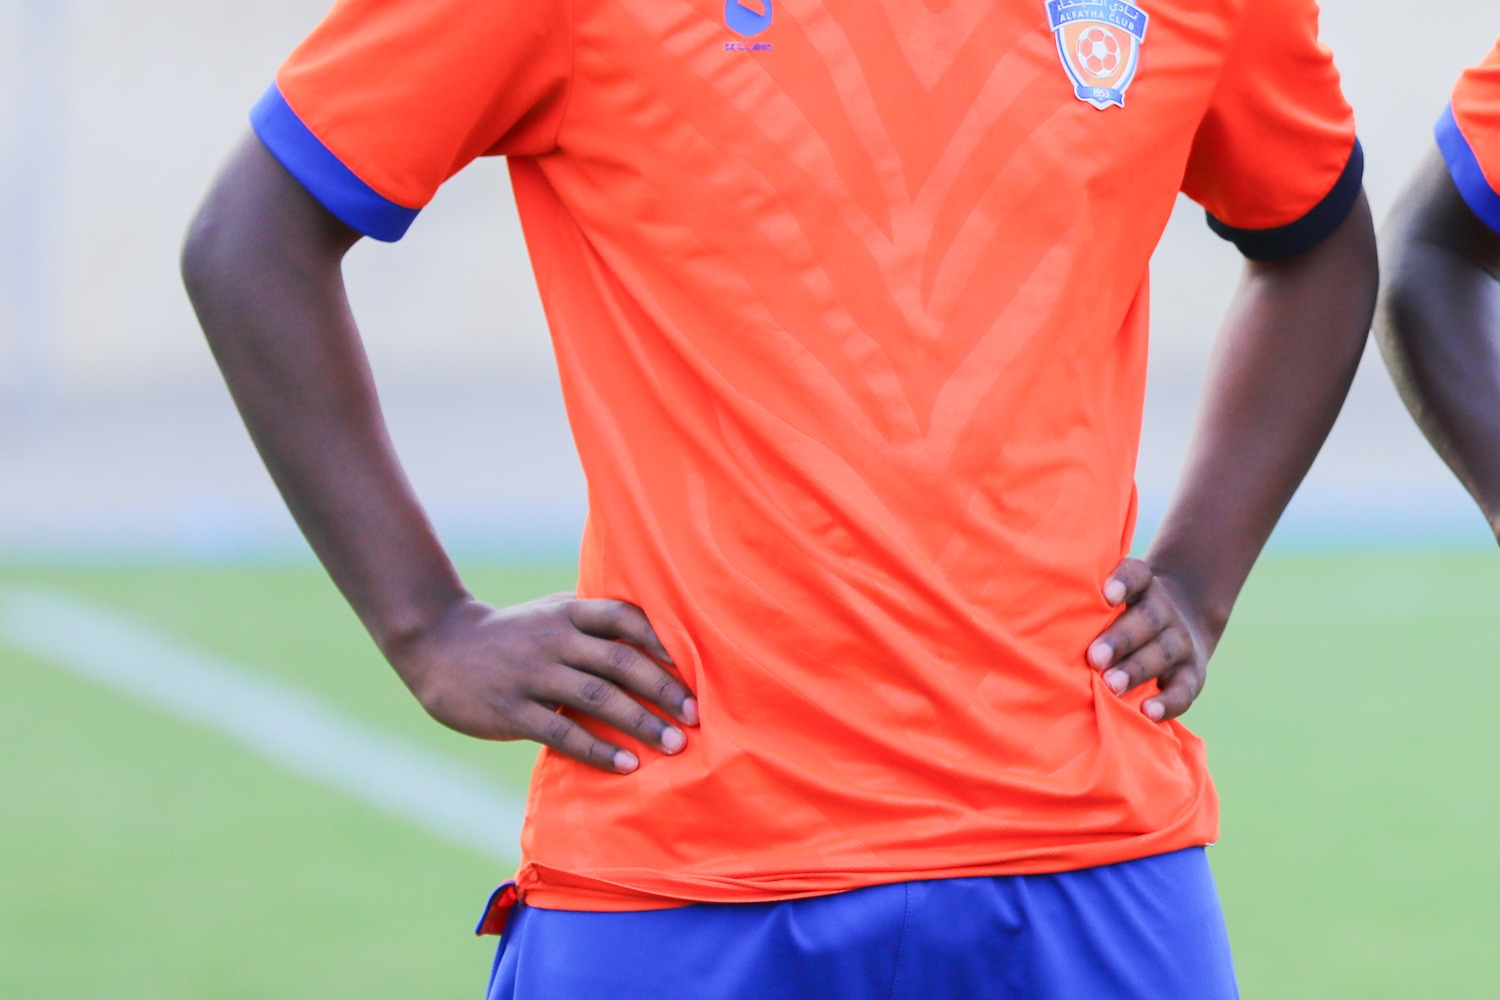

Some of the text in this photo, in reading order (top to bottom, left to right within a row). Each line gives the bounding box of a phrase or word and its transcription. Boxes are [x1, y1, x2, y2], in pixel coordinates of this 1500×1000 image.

[1060, 10, 1134, 30] ALFAYHA CLUB
[1109, 4, 1139, 20] نادي
